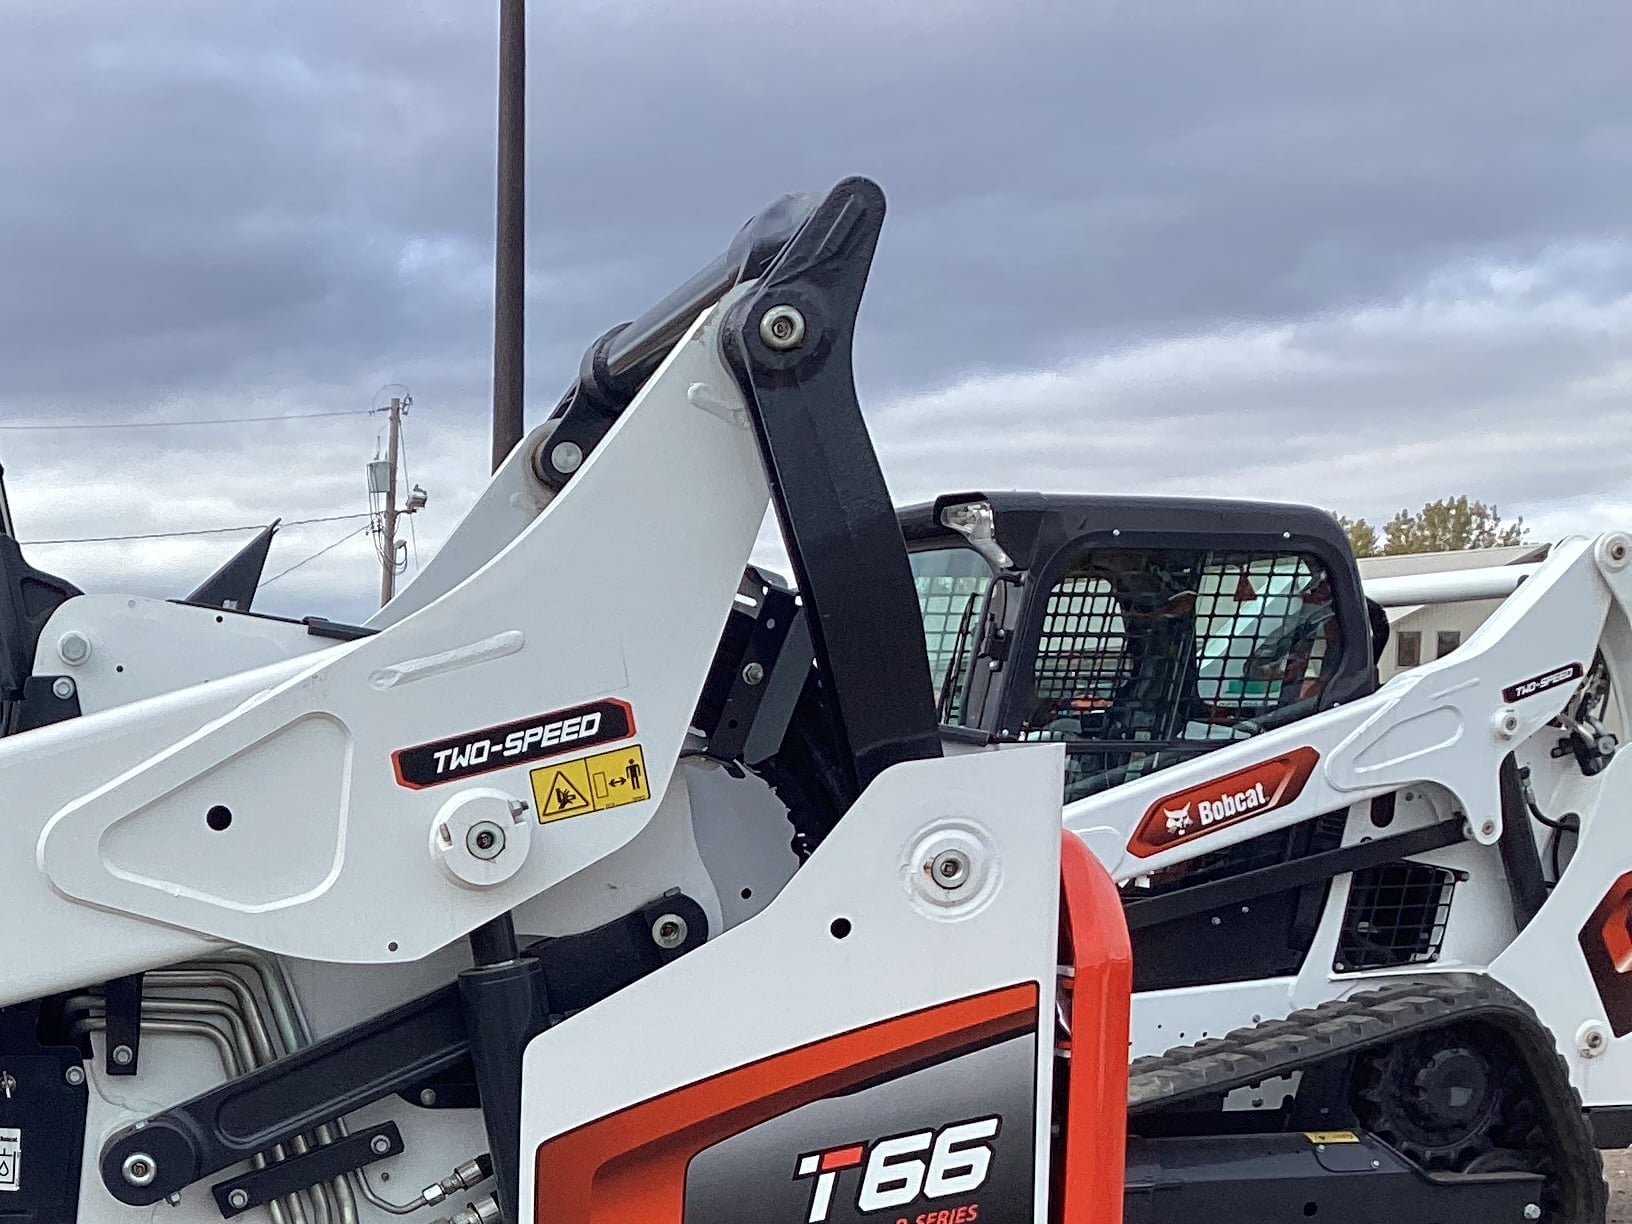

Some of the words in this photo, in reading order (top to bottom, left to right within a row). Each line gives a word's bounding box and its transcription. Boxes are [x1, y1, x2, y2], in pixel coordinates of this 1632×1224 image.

[433, 711, 601, 774] TWO-SPEED
[1198, 782, 1266, 825] Bobcat
[798, 1117, 999, 1224] T66
